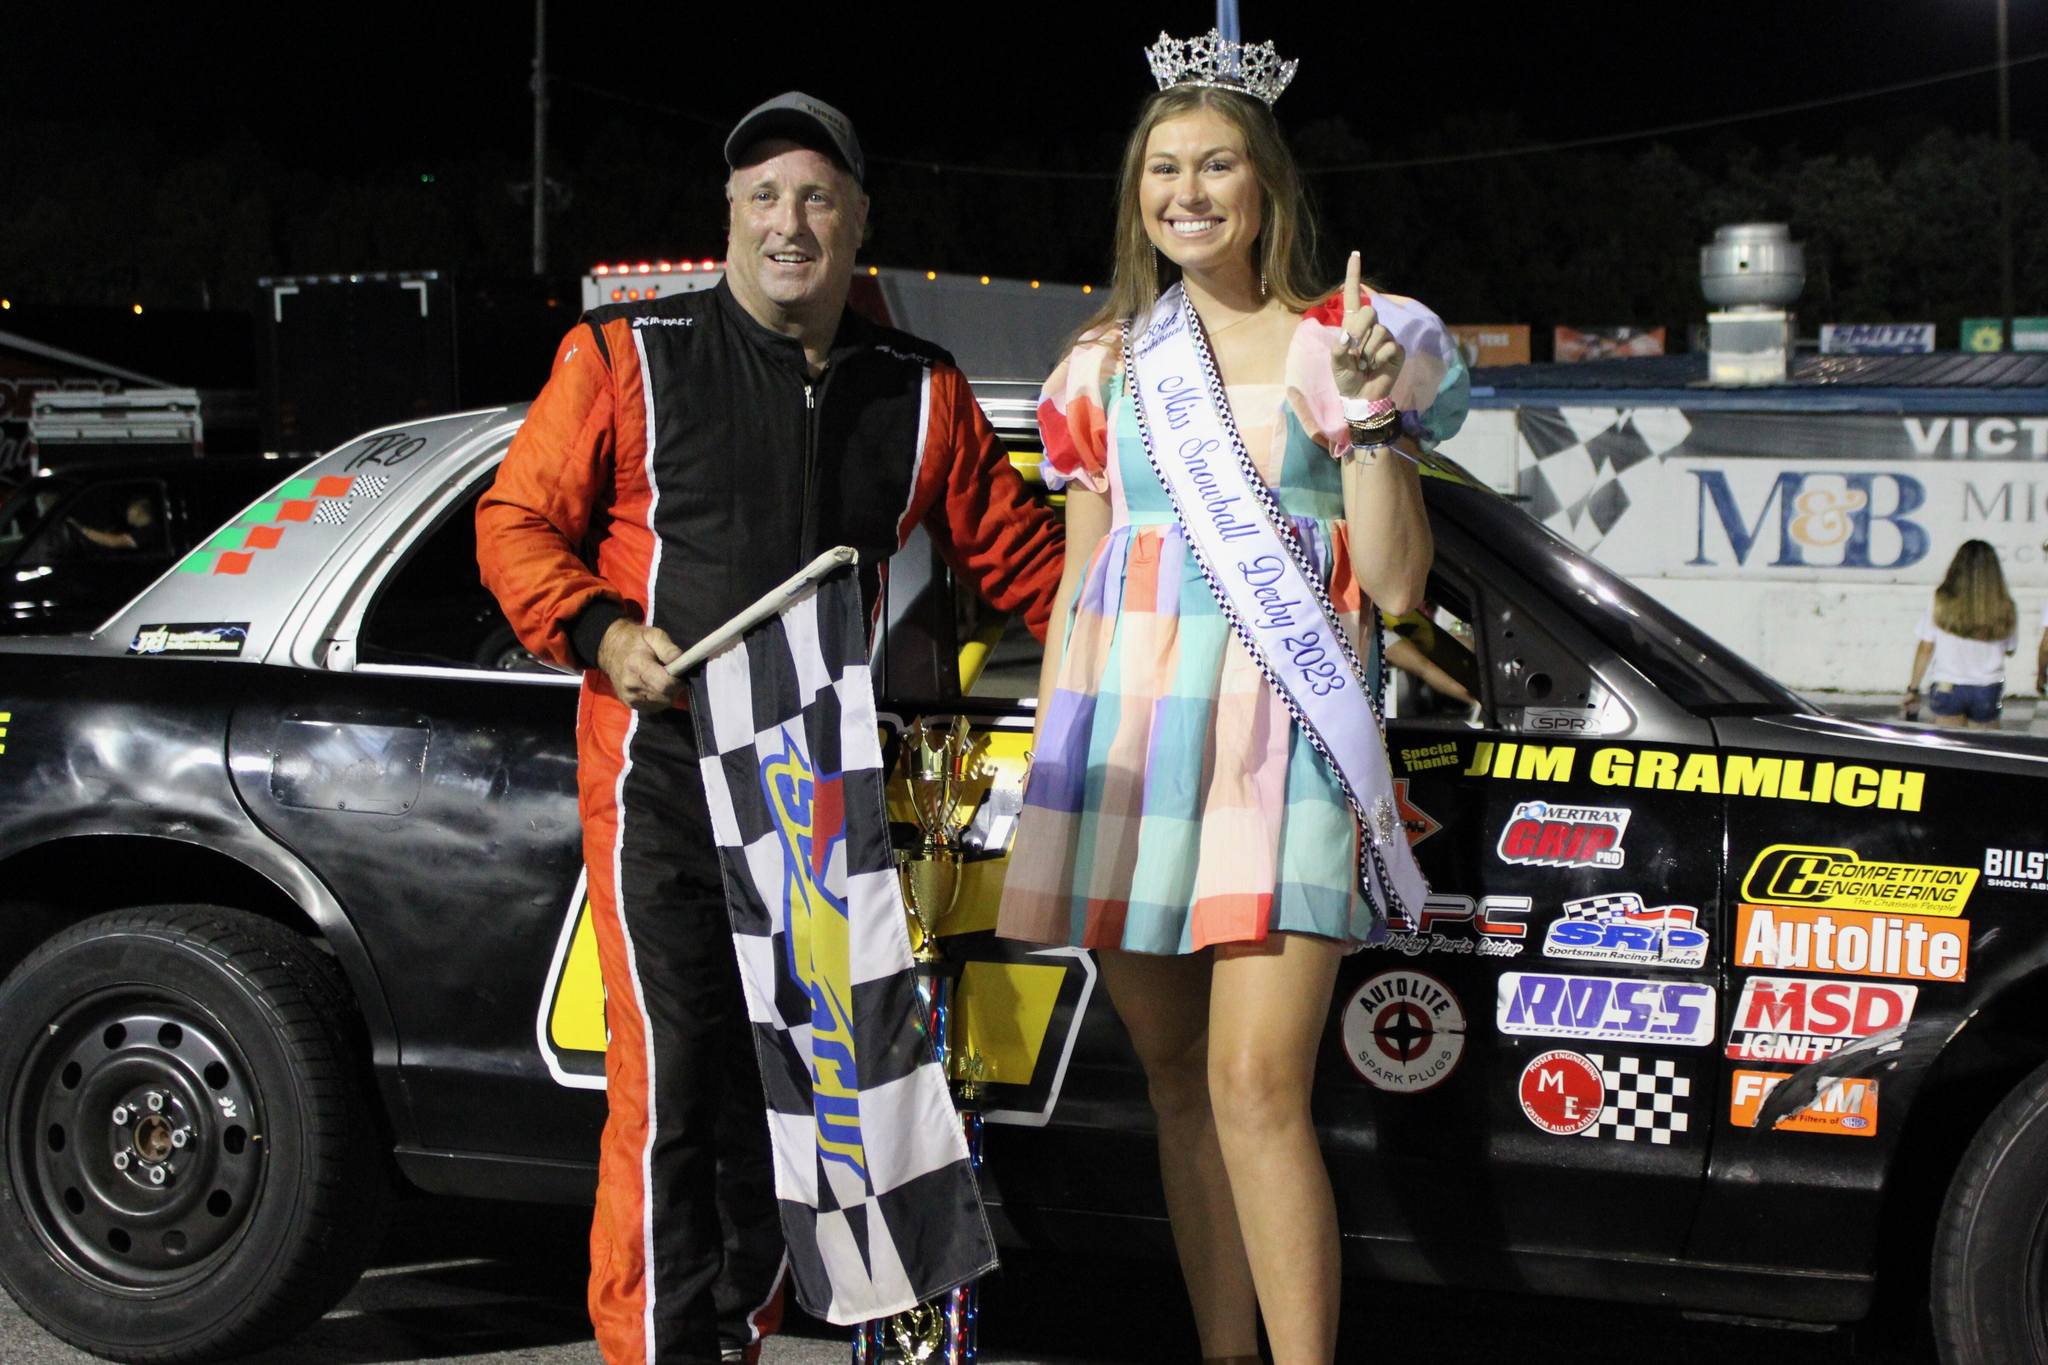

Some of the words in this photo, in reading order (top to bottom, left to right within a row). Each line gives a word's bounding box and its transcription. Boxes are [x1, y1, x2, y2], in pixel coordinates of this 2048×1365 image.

[1157, 375, 1196, 430] Miss
[1904, 417, 2048, 455] VICT
[1179, 438, 1260, 543] Snowball
[1961, 481, 2048, 522] MI
[1686, 468, 1931, 569] M&B
[1238, 555, 1302, 633] Derby
[1281, 631, 1346, 697] 2023
[1538, 717, 1586, 730] SPR
[1401, 742, 1457, 761] Special
[1404, 754, 1459, 772] Thanks
[1464, 742, 1576, 782] JIM
[1590, 748, 1926, 812] GRAMLICH
[1517, 803, 1623, 822] POWERTRAX
[1503, 820, 1617, 861] GRIP
[1596, 851, 1620, 864] PRO
[1984, 848, 2048, 880] BILS
[1828, 863, 1968, 885] COMPETITION
[1987, 878, 2028, 889] SHOCK
[2030, 881, 2048, 891] AB
[1818, 880, 1958, 902] ENGINEERING
[1854, 896, 1872, 906] The
[1874, 898, 1918, 909] Chassis
[1921, 902, 1957, 912] People
[1546, 946, 1608, 958] Sportsman
[1609, 952, 1649, 963] Racing
[1742, 910, 1961, 978] Autolite
[1360, 978, 1451, 1015] AUTOLITE
[1506, 976, 1709, 1035] ROSS
[1744, 980, 1904, 1037] MSD
[1503, 1025, 1590, 1037] racing
[1358, 1051, 1404, 1084] SPARK
[1408, 1050, 1452, 1084] PLUGS
[1538, 1068, 1564, 1094] M
[1524, 1101, 1549, 1128] CUSTOM
[1550, 1124, 1576, 1132] ALLOY
[1564, 1096, 1581, 1120] E
